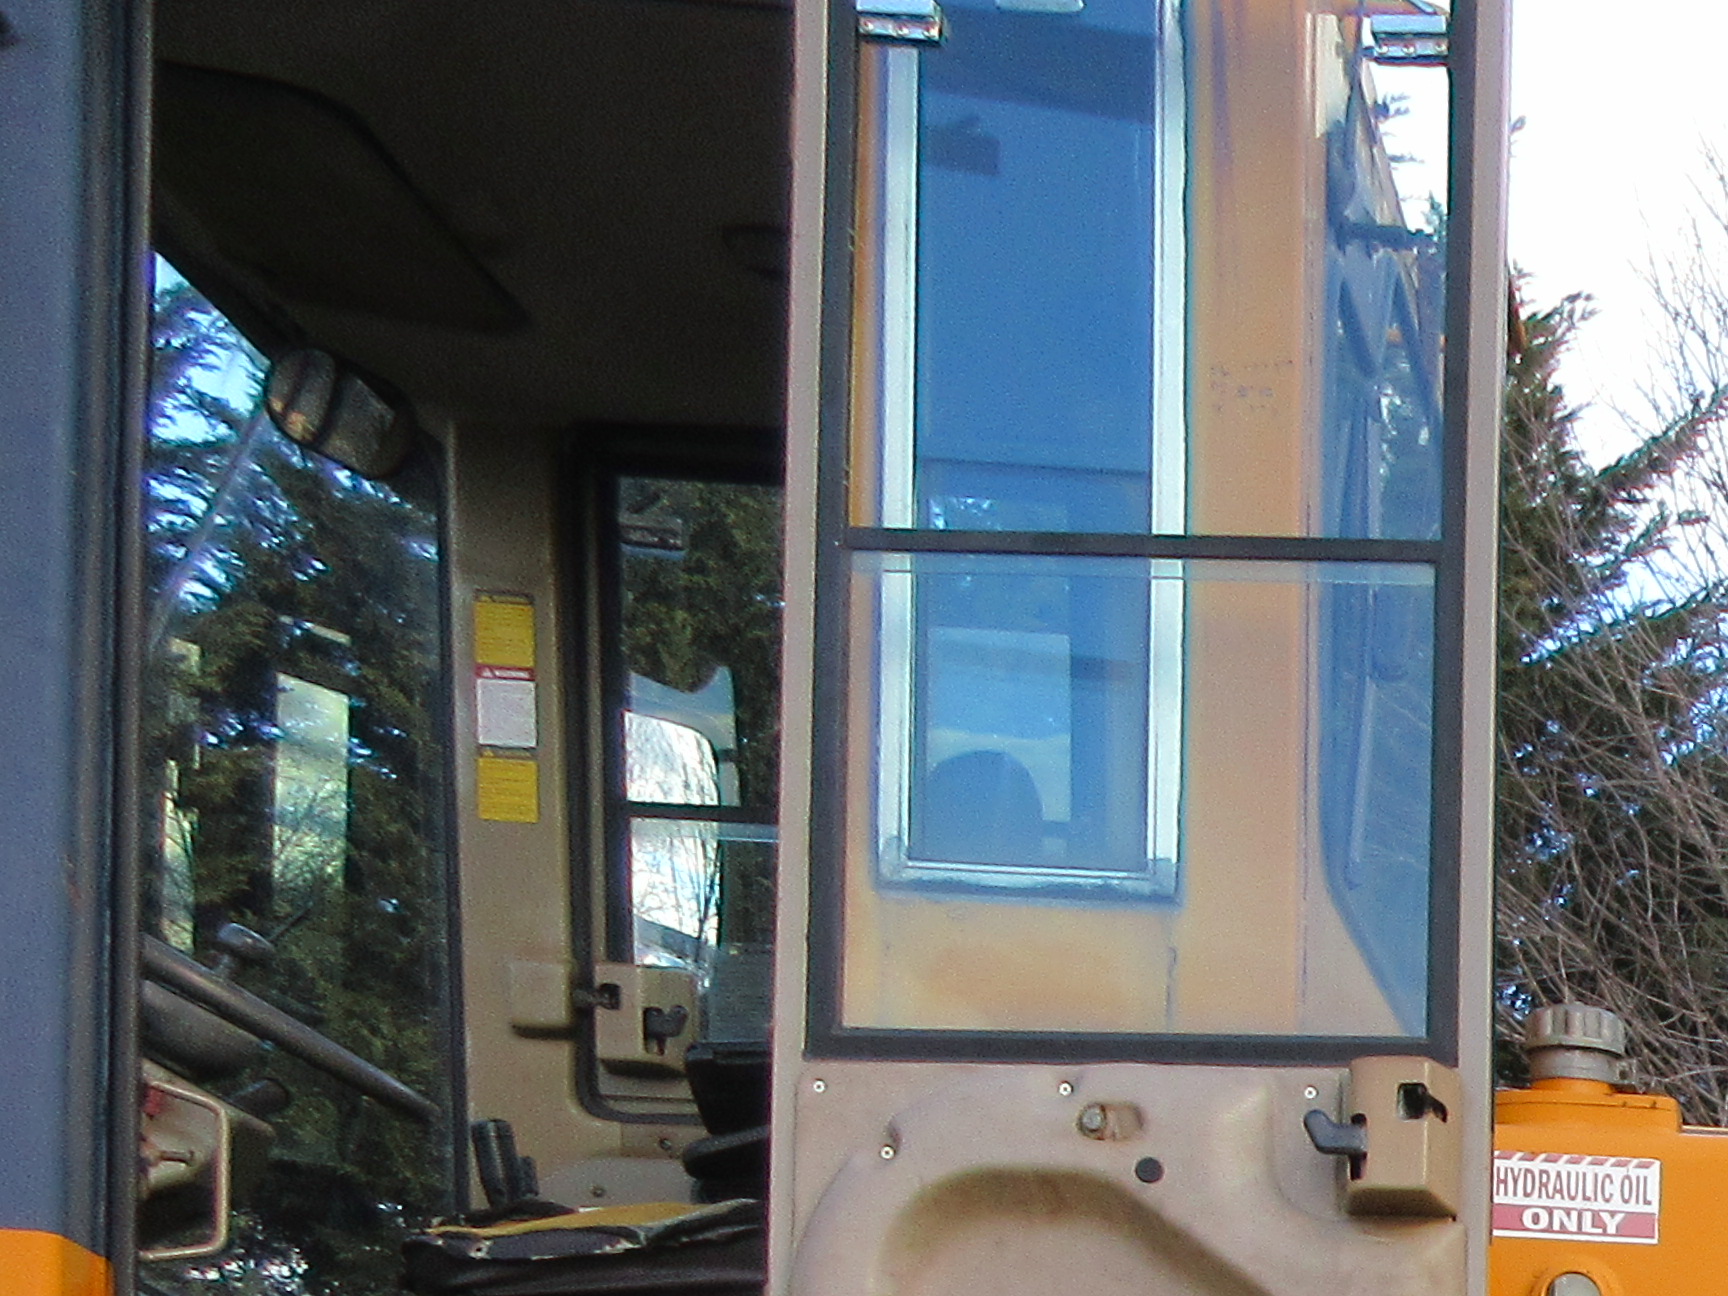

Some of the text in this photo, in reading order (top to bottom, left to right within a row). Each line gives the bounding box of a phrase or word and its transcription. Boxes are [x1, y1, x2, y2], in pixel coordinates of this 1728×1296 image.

[1495, 1165, 1652, 1206] HYDRAULIC OIL
[1520, 1207, 1626, 1235] ONLY
